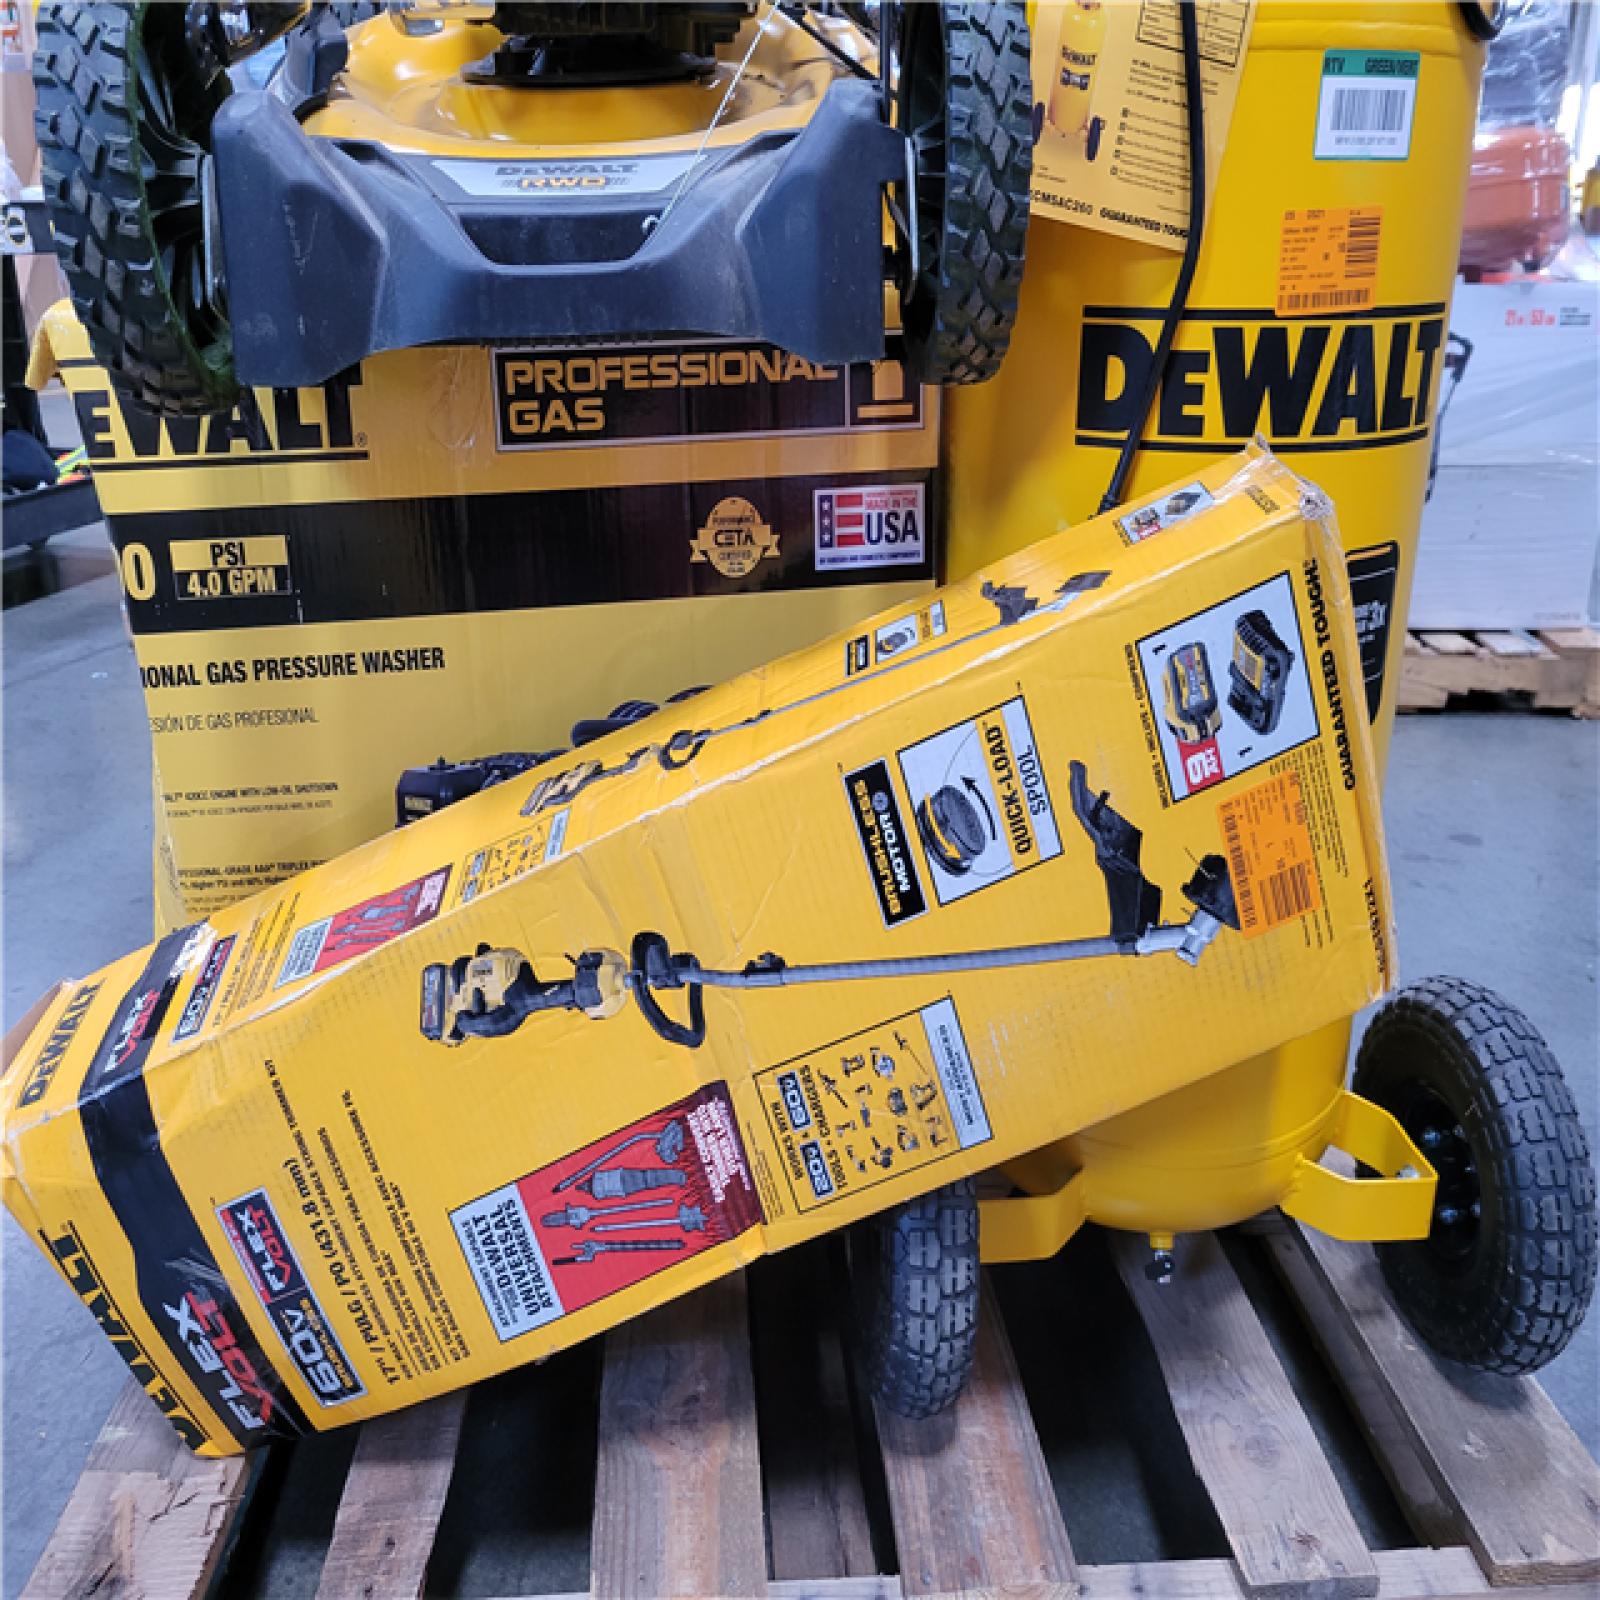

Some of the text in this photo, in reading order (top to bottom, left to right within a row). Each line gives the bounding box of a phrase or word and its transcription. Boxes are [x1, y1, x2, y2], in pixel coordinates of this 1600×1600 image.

[495, 164, 639, 176] DEWALT
[505, 351, 839, 395] PROFESSIONAL
[1077, 318, 1444, 438] DEWALT
[508, 399, 607, 434] GAS
[209, 542, 246, 567] PSI
[711, 528, 754, 546] CETA
[864, 510, 920, 546] USA
[187, 568, 277, 598] 4.0 GPM
[206, 659, 249, 685] GAS
[253, 652, 358, 683] PRESSURE
[360, 647, 446, 674] WASHER
[1016, 748, 1047, 817] SPOOL
[877, 811, 912, 893] MOTOR
[18, 982, 104, 1107] DEWALT
[234, 1207, 287, 1293] FLEX
[247, 1200, 296, 1283] VOLT
[326, 1259, 351, 1287] PO
[470, 1212, 512, 1288] DEWALT
[486, 1203, 541, 1316] UNIVERSAL
[501, 1198, 554, 1310] ATTACHMENTS
[183, 1286, 282, 1421] VOLT
[280, 1304, 342, 1395] 60V
[344, 1297, 379, 1346] PULG
[163, 1296, 266, 1430] FLEX
